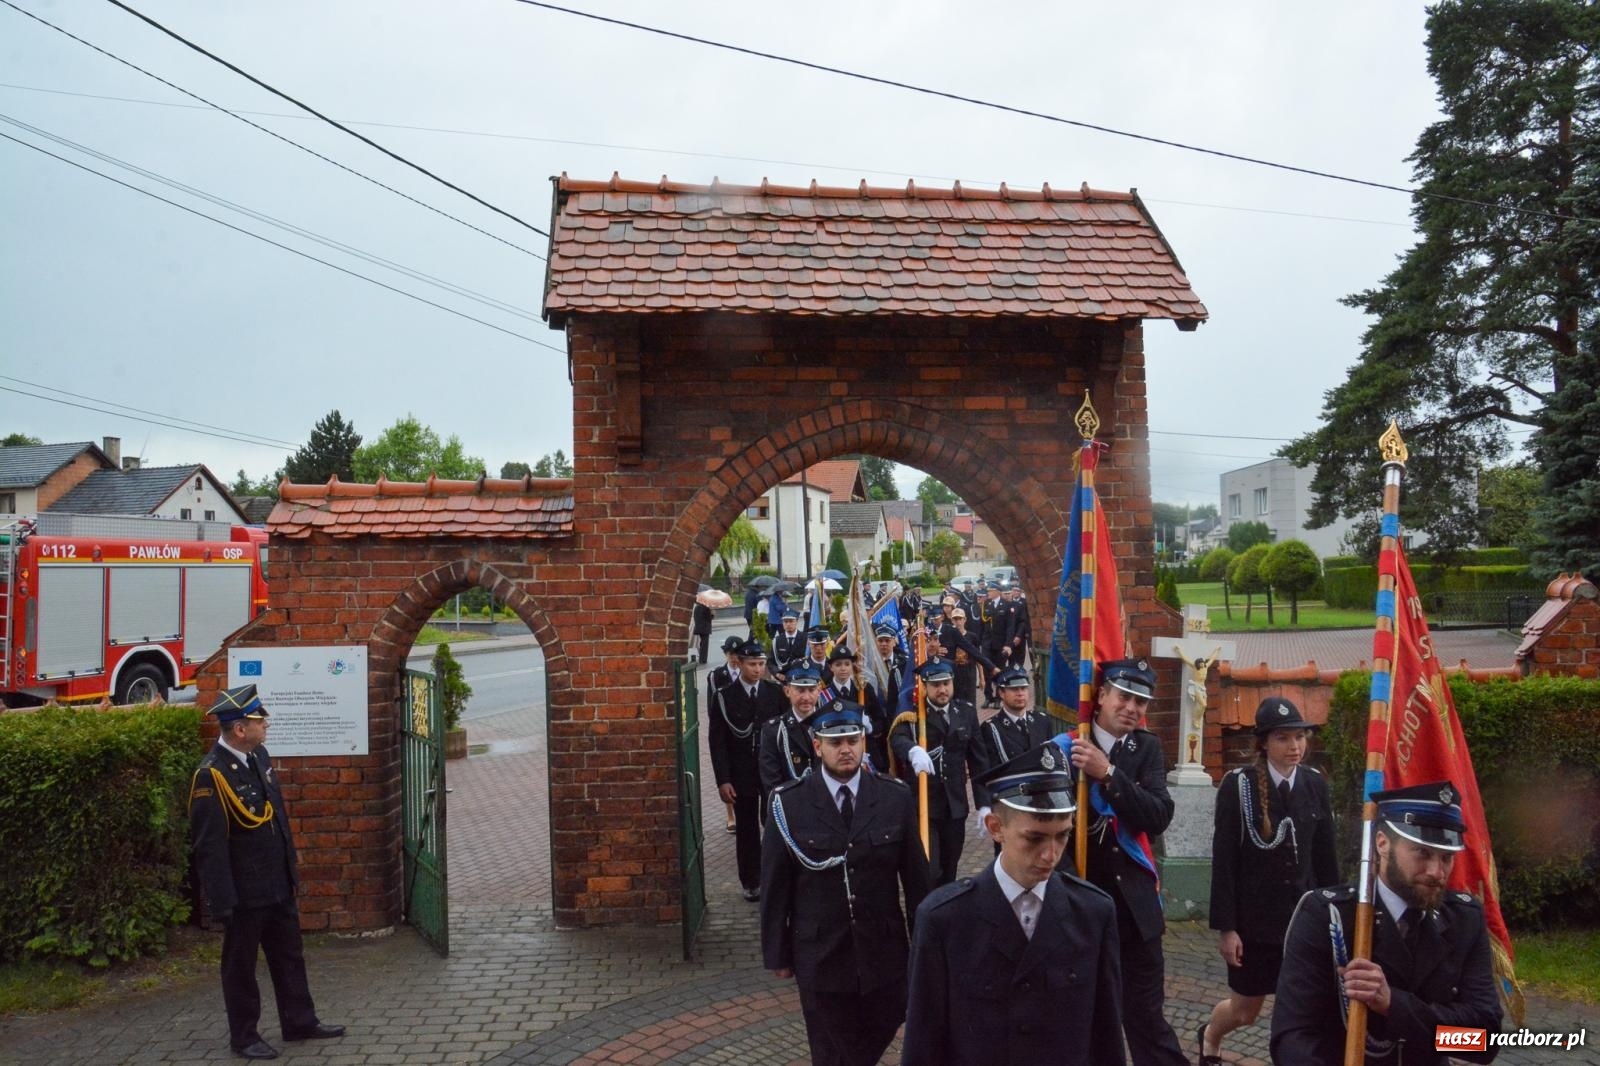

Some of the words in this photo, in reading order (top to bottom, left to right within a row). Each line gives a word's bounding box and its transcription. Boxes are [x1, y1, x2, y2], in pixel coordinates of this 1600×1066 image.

[51, 544, 77, 558] 112
[129, 543, 181, 559] PAWŁÓW
[223, 548, 243, 560] OSP
